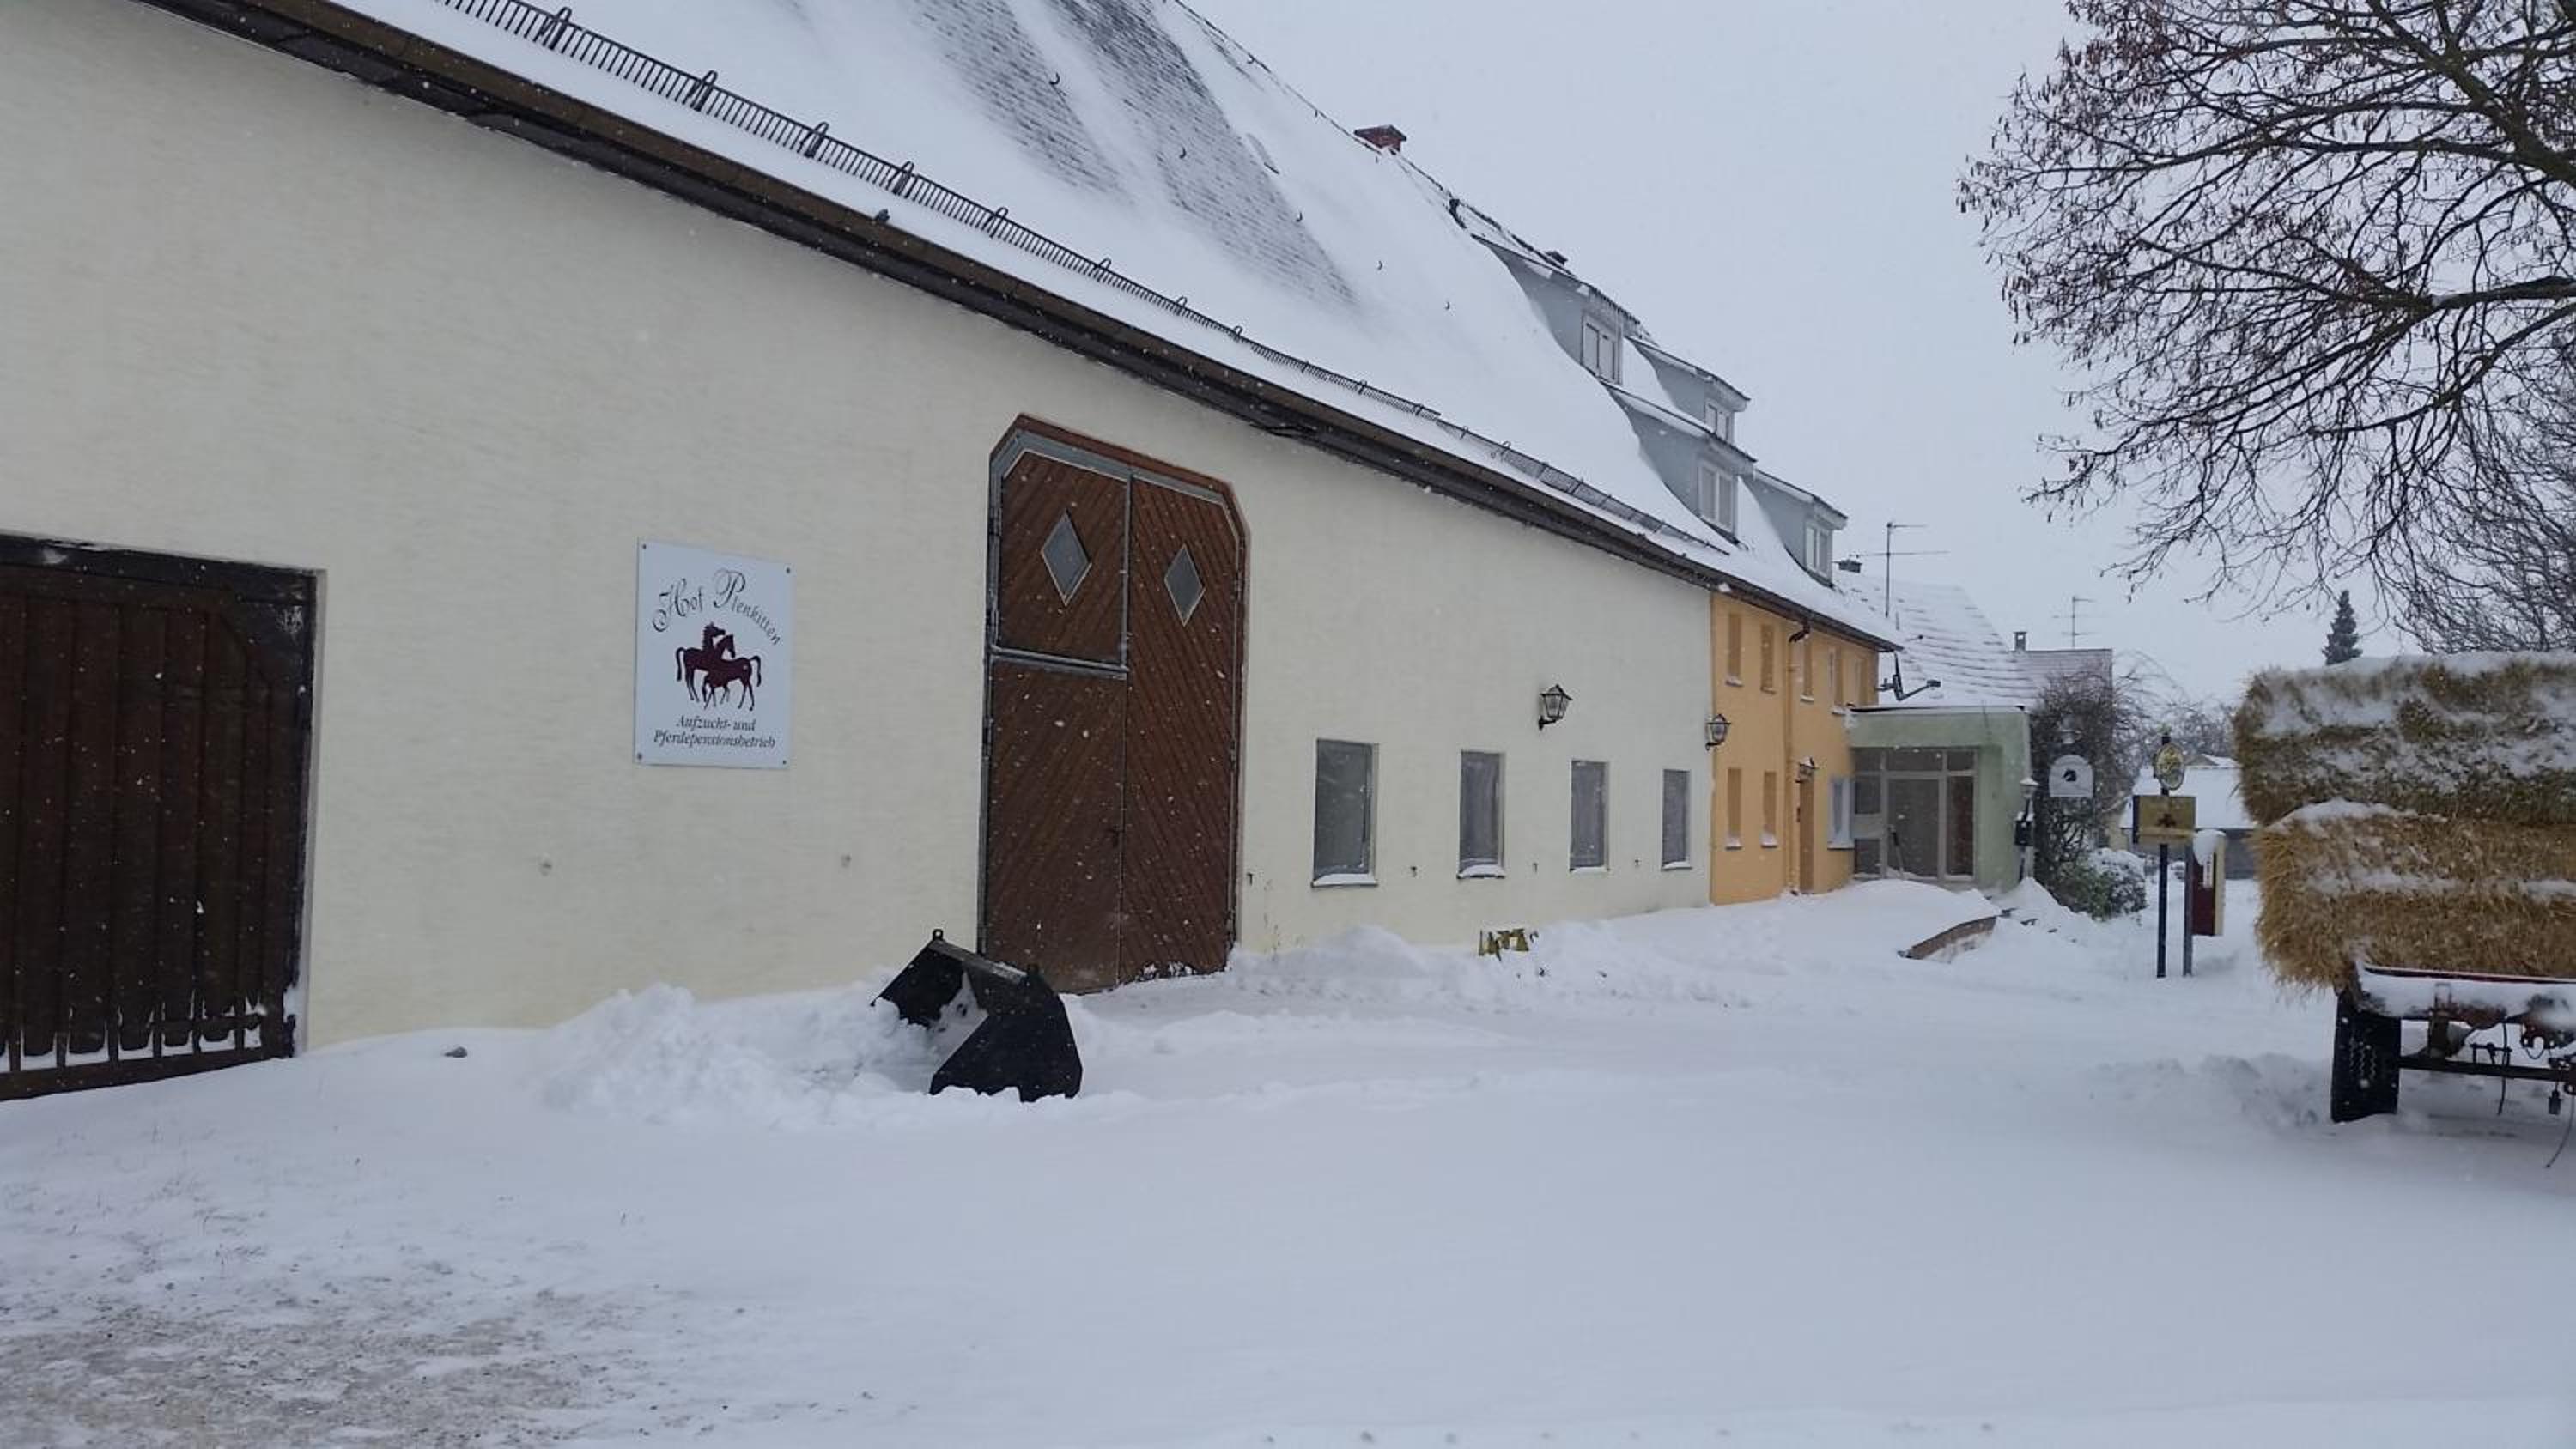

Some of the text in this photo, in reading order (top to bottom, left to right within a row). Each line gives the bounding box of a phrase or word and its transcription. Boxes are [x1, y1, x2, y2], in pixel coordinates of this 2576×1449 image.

[652, 578, 703, 632] Hof
[676, 715, 756, 731] Aufzucht- und
[653, 730, 776, 749] Pferdepensionsbetrieb
